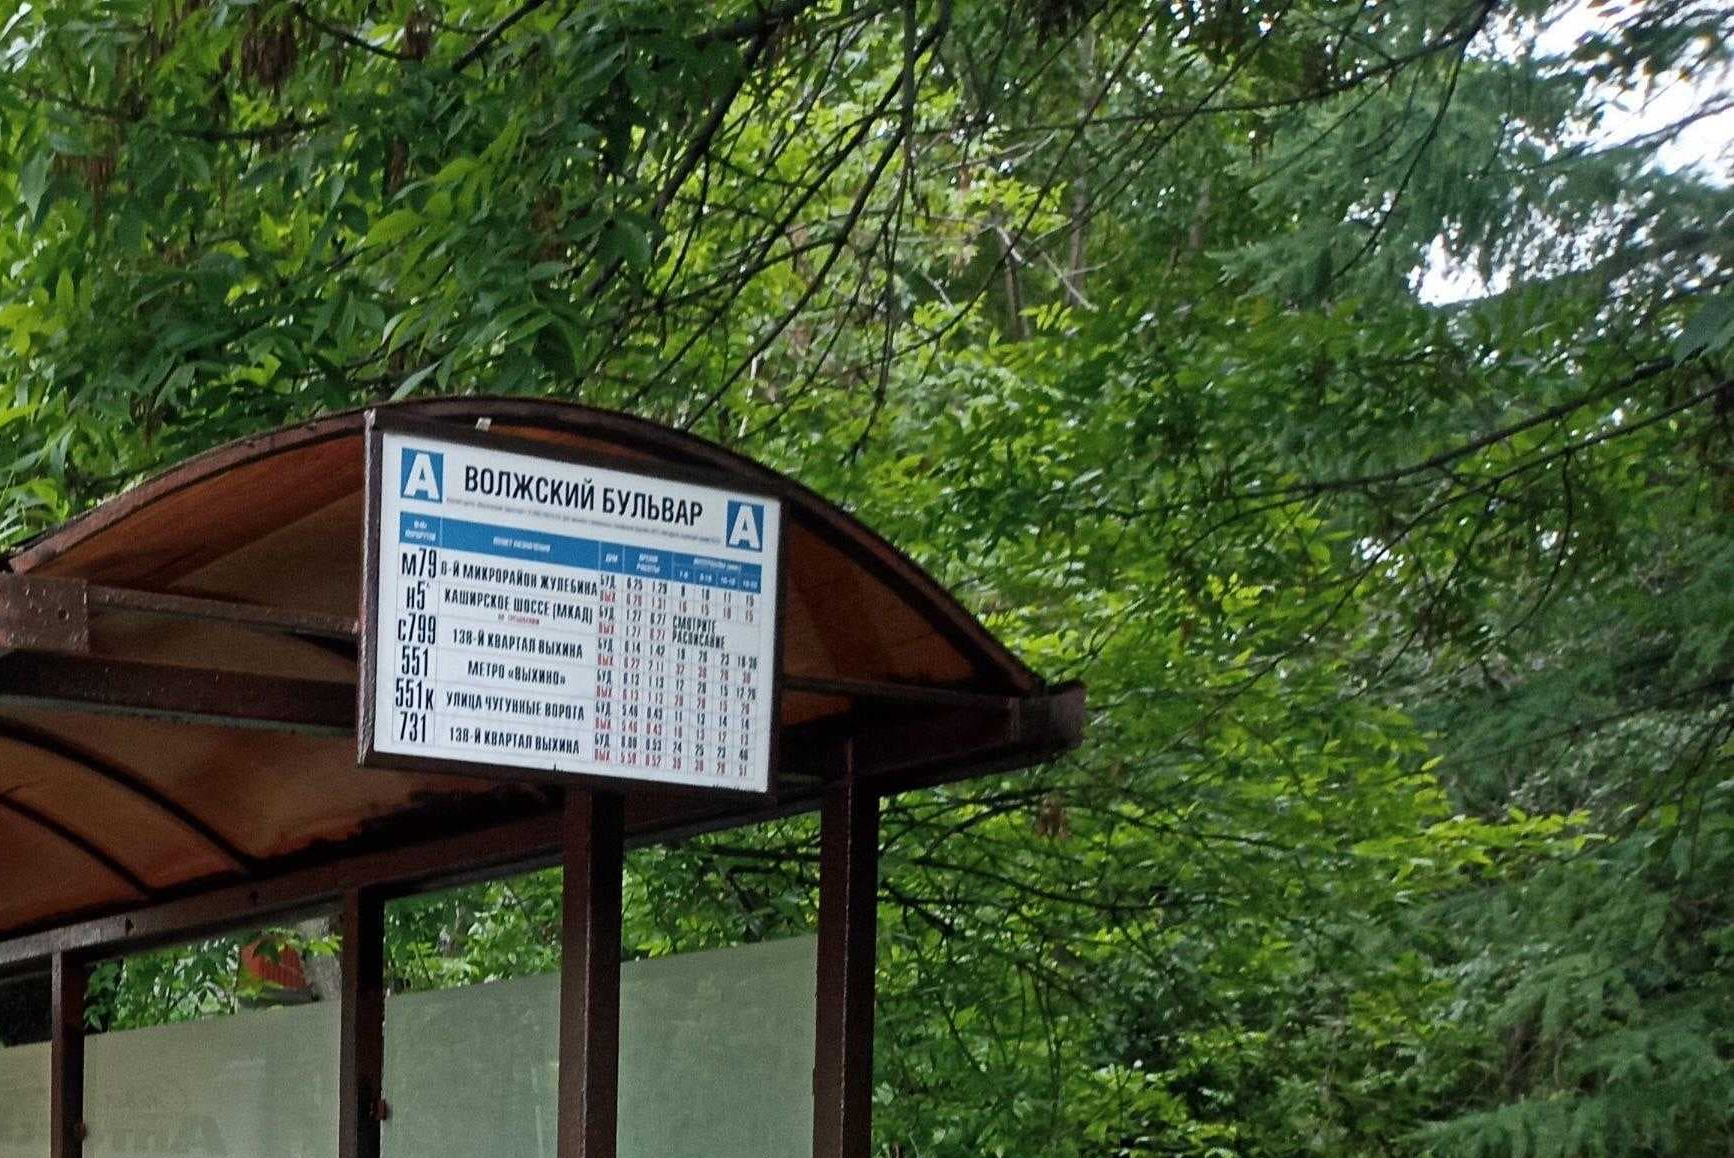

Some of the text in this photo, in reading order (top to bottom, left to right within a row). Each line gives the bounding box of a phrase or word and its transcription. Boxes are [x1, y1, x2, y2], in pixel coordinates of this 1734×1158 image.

[464, 464, 703, 526] ВОЛЖСКИЙ БУЛЬВАР
[462, 563, 537, 588] МИКРОРАЙОН
[539, 574, 597, 596] ЖУЛЕБИНА
[444, 587, 509, 611] КАШИРСКОЕ
[513, 596, 549, 616] ШОССЕ
[552, 602, 593, 625] (МКАД)
[400, 644, 428, 678] 551
[486, 632, 536, 653] КВАРТАЛ
[537, 638, 582, 659] ВЫХИНА
[467, 659, 505, 679] МЕТРО
[446, 690, 584, 721] УЛИЦА ЧУГУННЫЕ ВОРОТА
[399, 710, 426, 744] 731
[483, 729, 532, 749] КВАРТАЛ
[534, 735, 579, 754] ВЫХИНА
